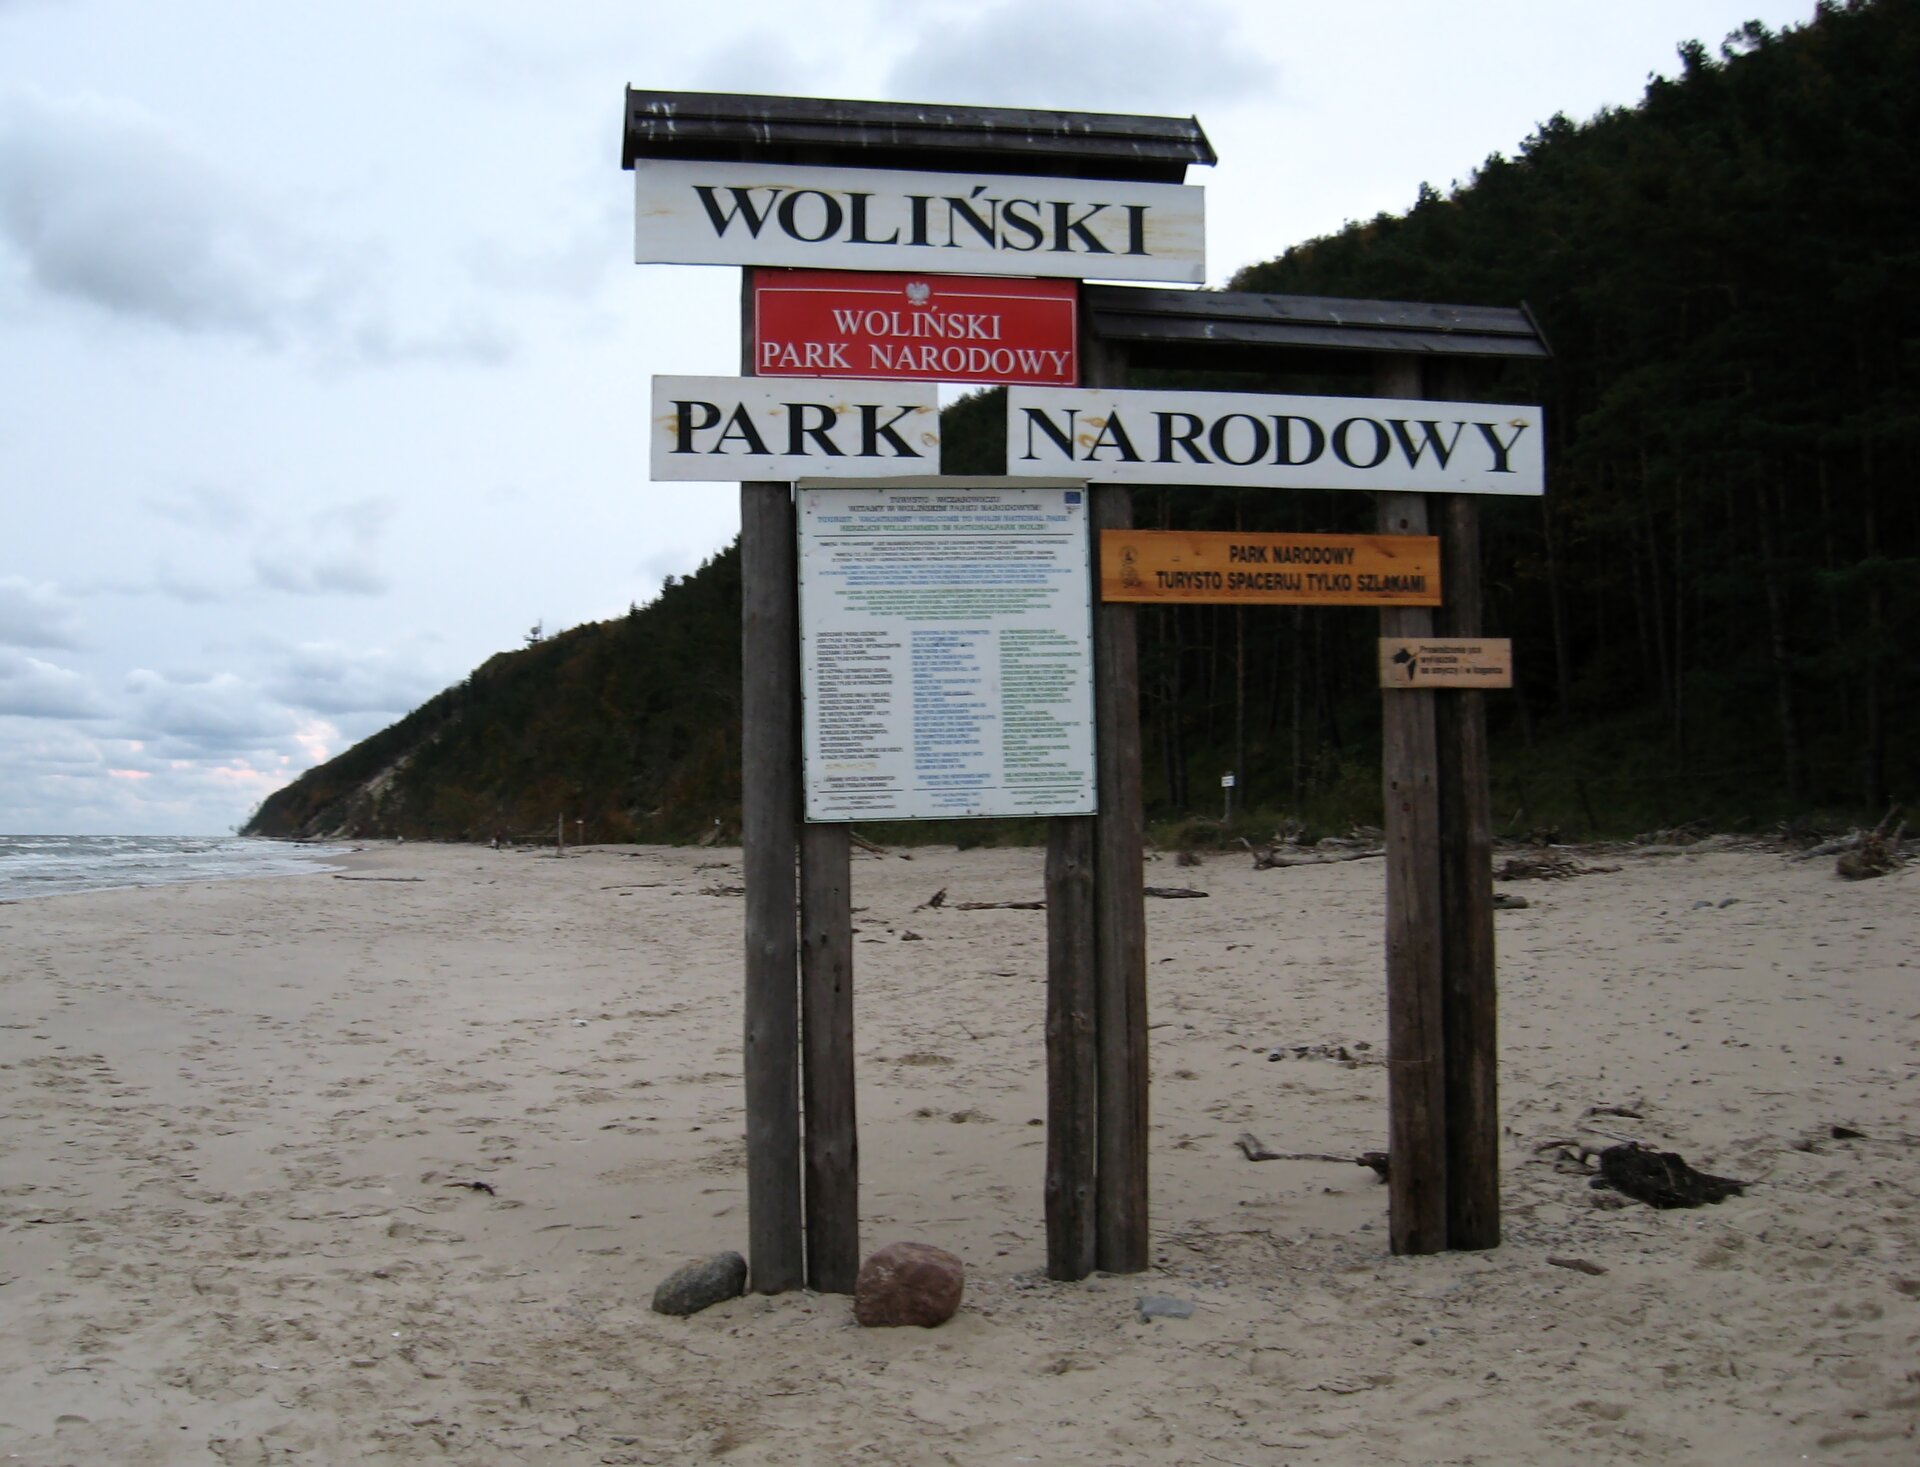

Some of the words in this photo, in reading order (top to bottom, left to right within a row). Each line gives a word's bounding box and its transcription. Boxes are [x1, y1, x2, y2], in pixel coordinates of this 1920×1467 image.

[692, 185, 1152, 256] WOLIŃSKI
[832, 305, 1002, 341] WOLIŃSKI
[761, 341, 853, 369] PARK
[869, 344, 1071, 376] NARODOWY
[669, 400, 926, 458] PARK
[1017, 406, 1531, 475] NARODOWY
[1229, 544, 1269, 564] PARK
[1273, 545, 1355, 566] NARODOWY
[1155, 570, 1223, 589] TURYSTO
[1227, 571, 1302, 591] SPACERUJ
[1305, 572, 1353, 593] TYLKO
[1356, 573, 1426, 594] SZLAKAMI
